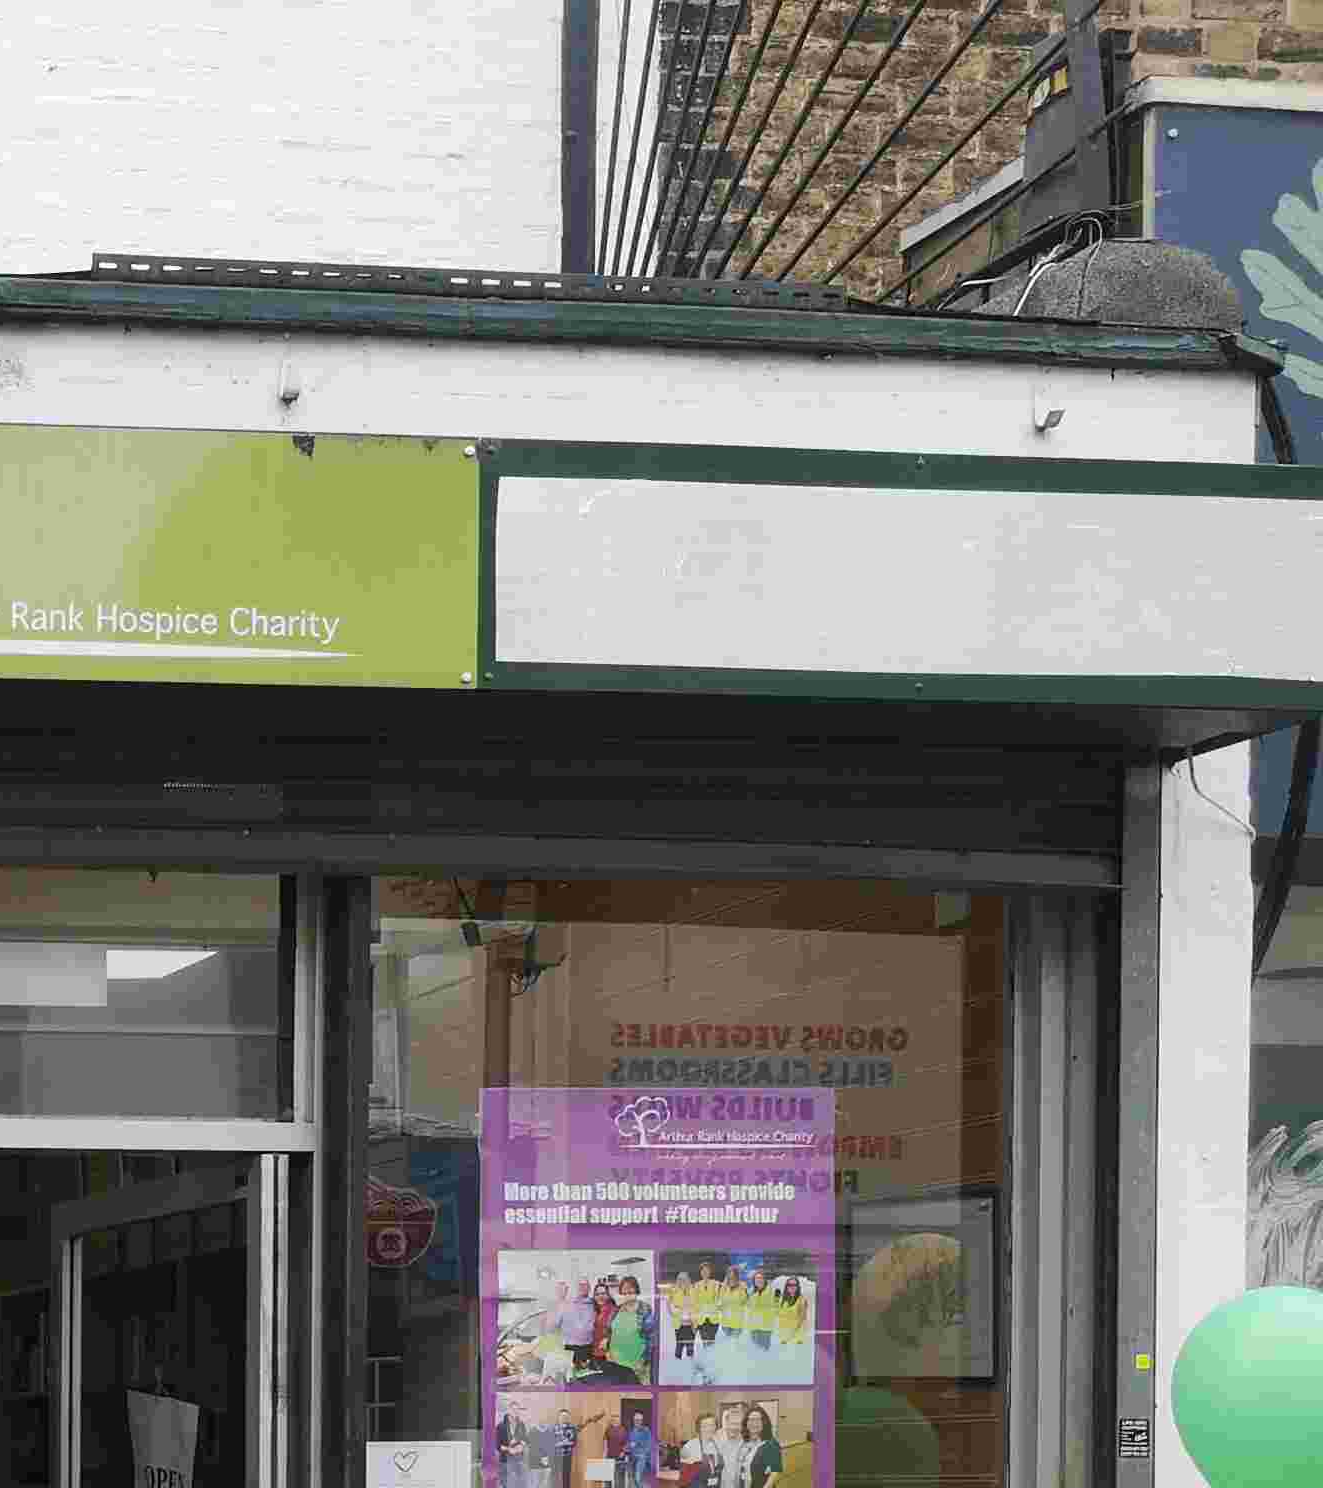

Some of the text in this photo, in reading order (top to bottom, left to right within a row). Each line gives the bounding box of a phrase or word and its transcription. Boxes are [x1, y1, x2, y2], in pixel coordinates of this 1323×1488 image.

[11, 601, 83, 632] Rank
[96, 603, 219, 640] Hospice
[230, 607, 340, 644] Charity
[504, 1182, 795, 1203] More than 500 volunteers provide
[504, 1204, 780, 1226] essential support #TeamArthur
